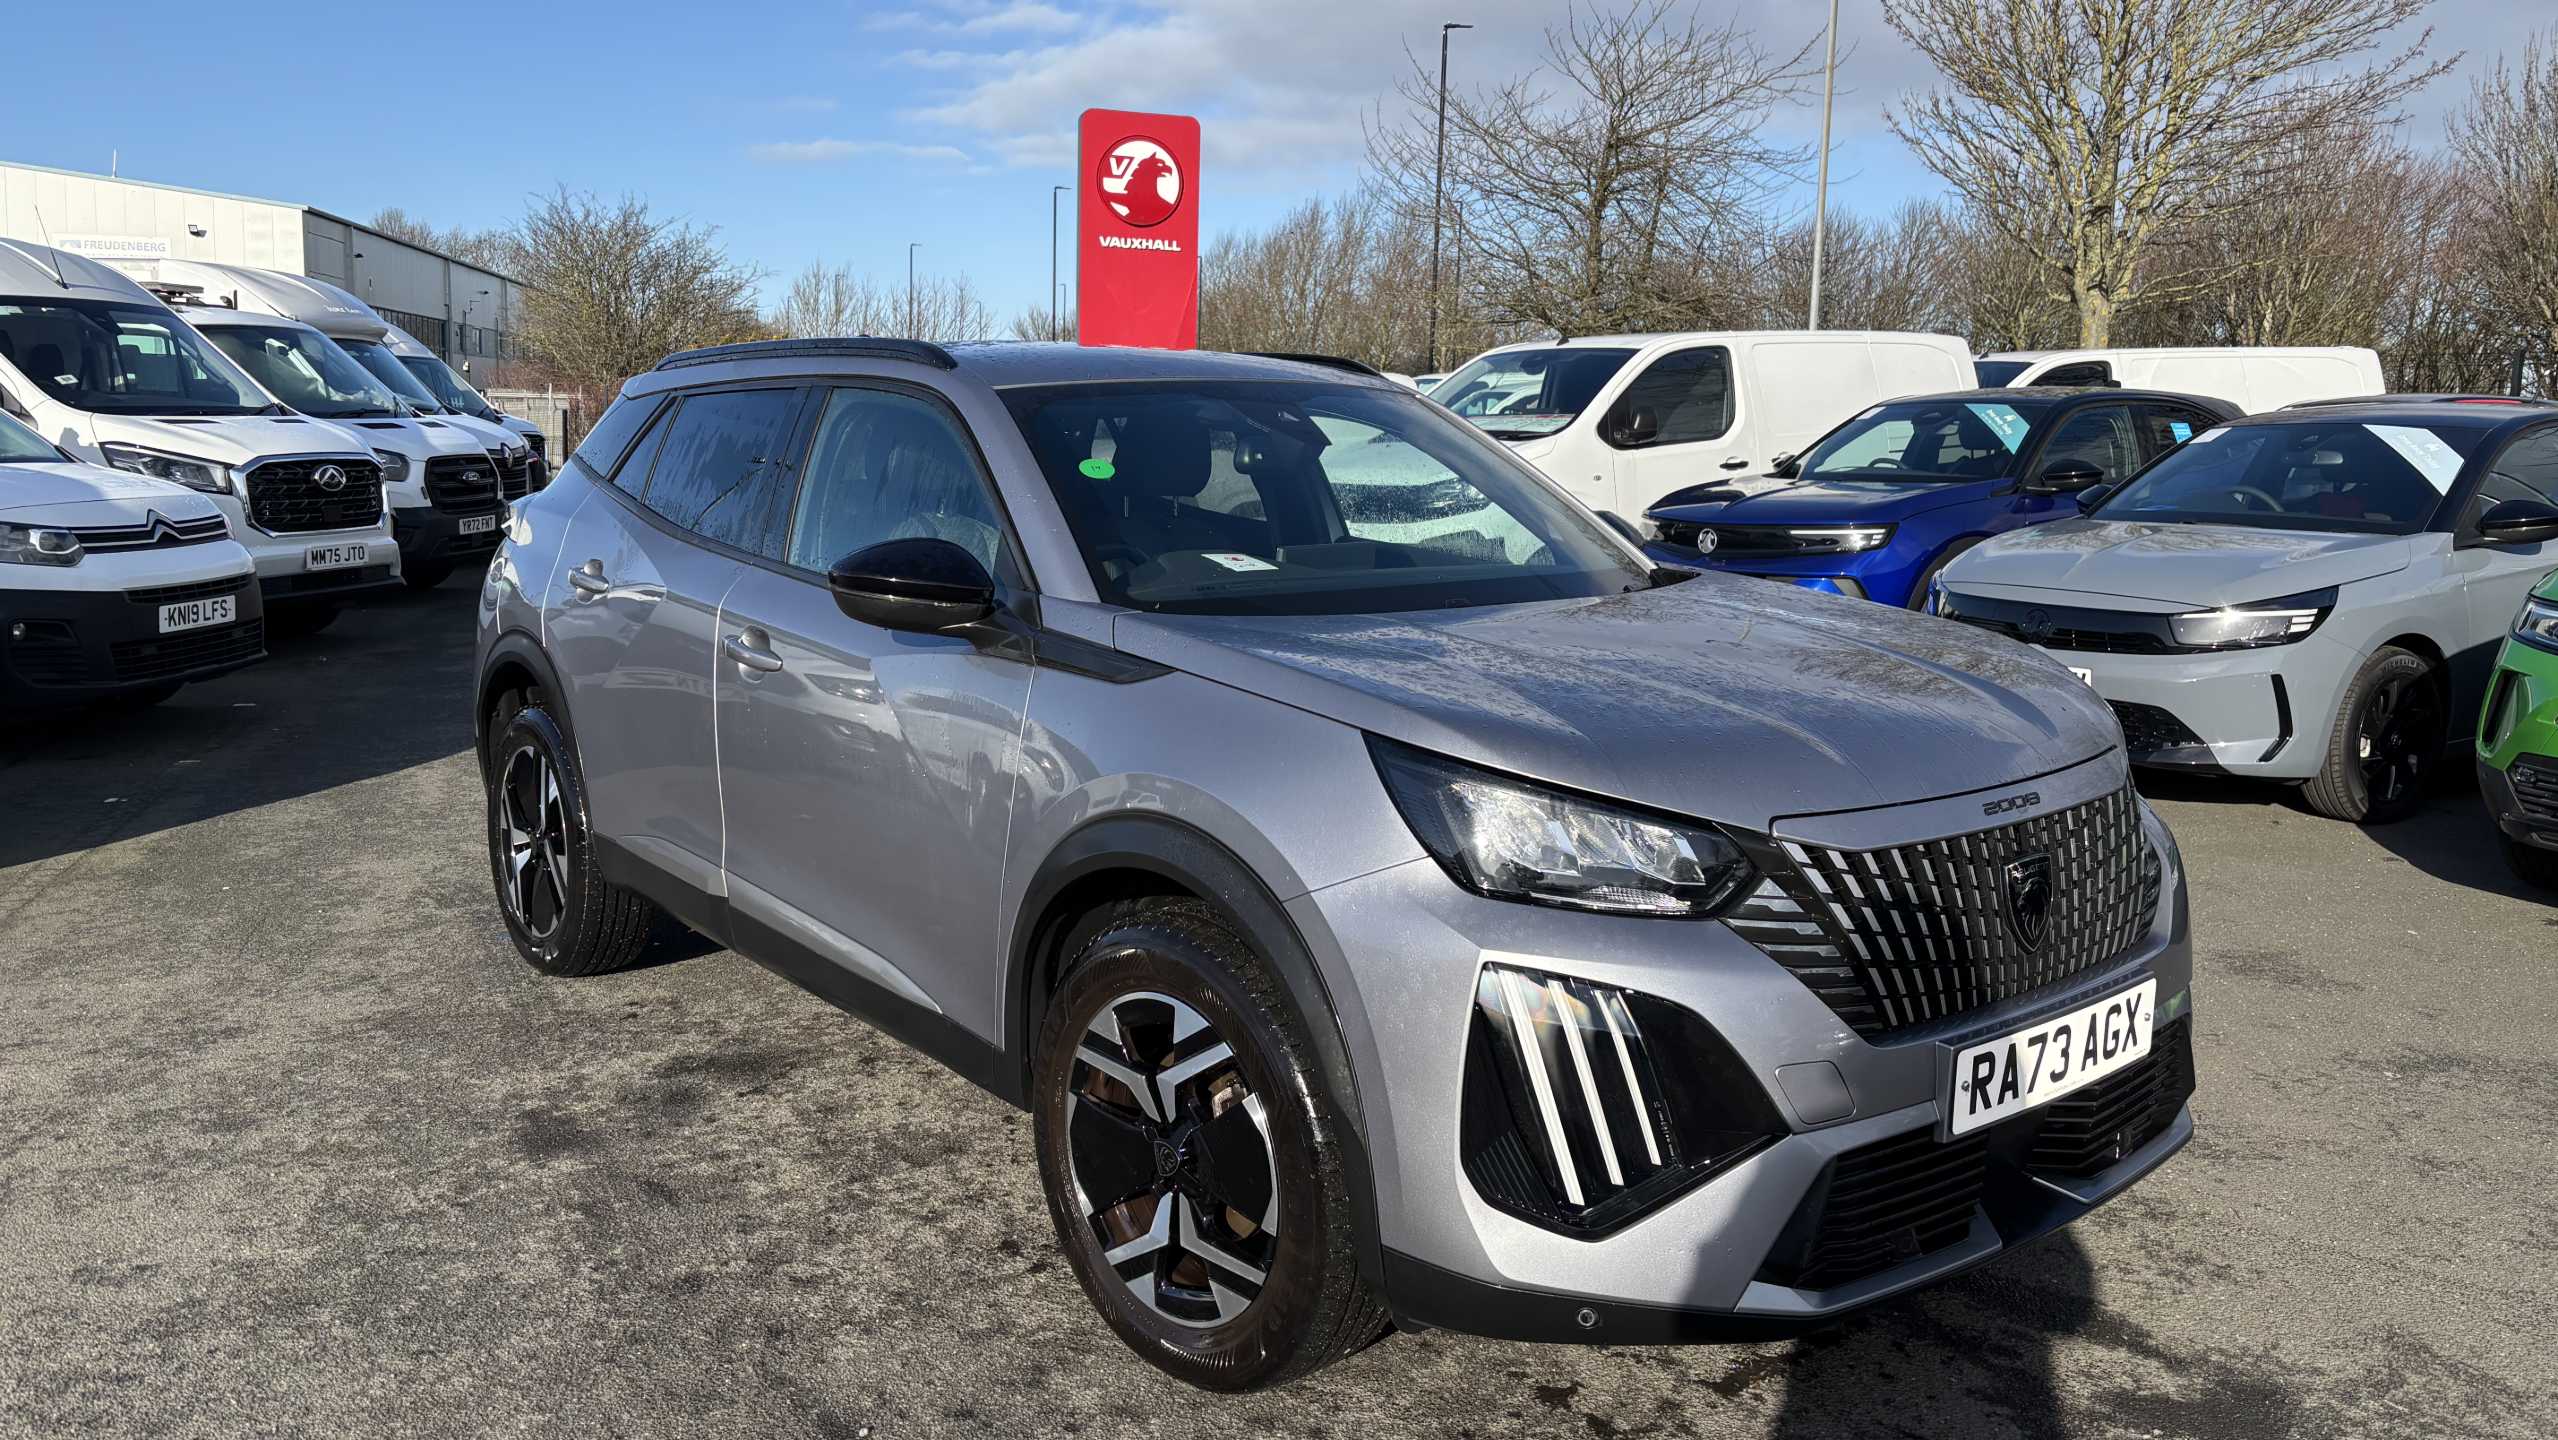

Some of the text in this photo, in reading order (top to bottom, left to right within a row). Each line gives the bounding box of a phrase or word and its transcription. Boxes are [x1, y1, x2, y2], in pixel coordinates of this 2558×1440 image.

[83, 240, 167, 253] FREUDENBERG
[1099, 235, 1182, 252] VAUXHALL
[311, 545, 365, 566] MM75 JTO
[167, 599, 228, 628] KN19 LFS
[1982, 791, 2041, 816] 2008
[1969, 992, 2142, 1115] RA73 AGX
